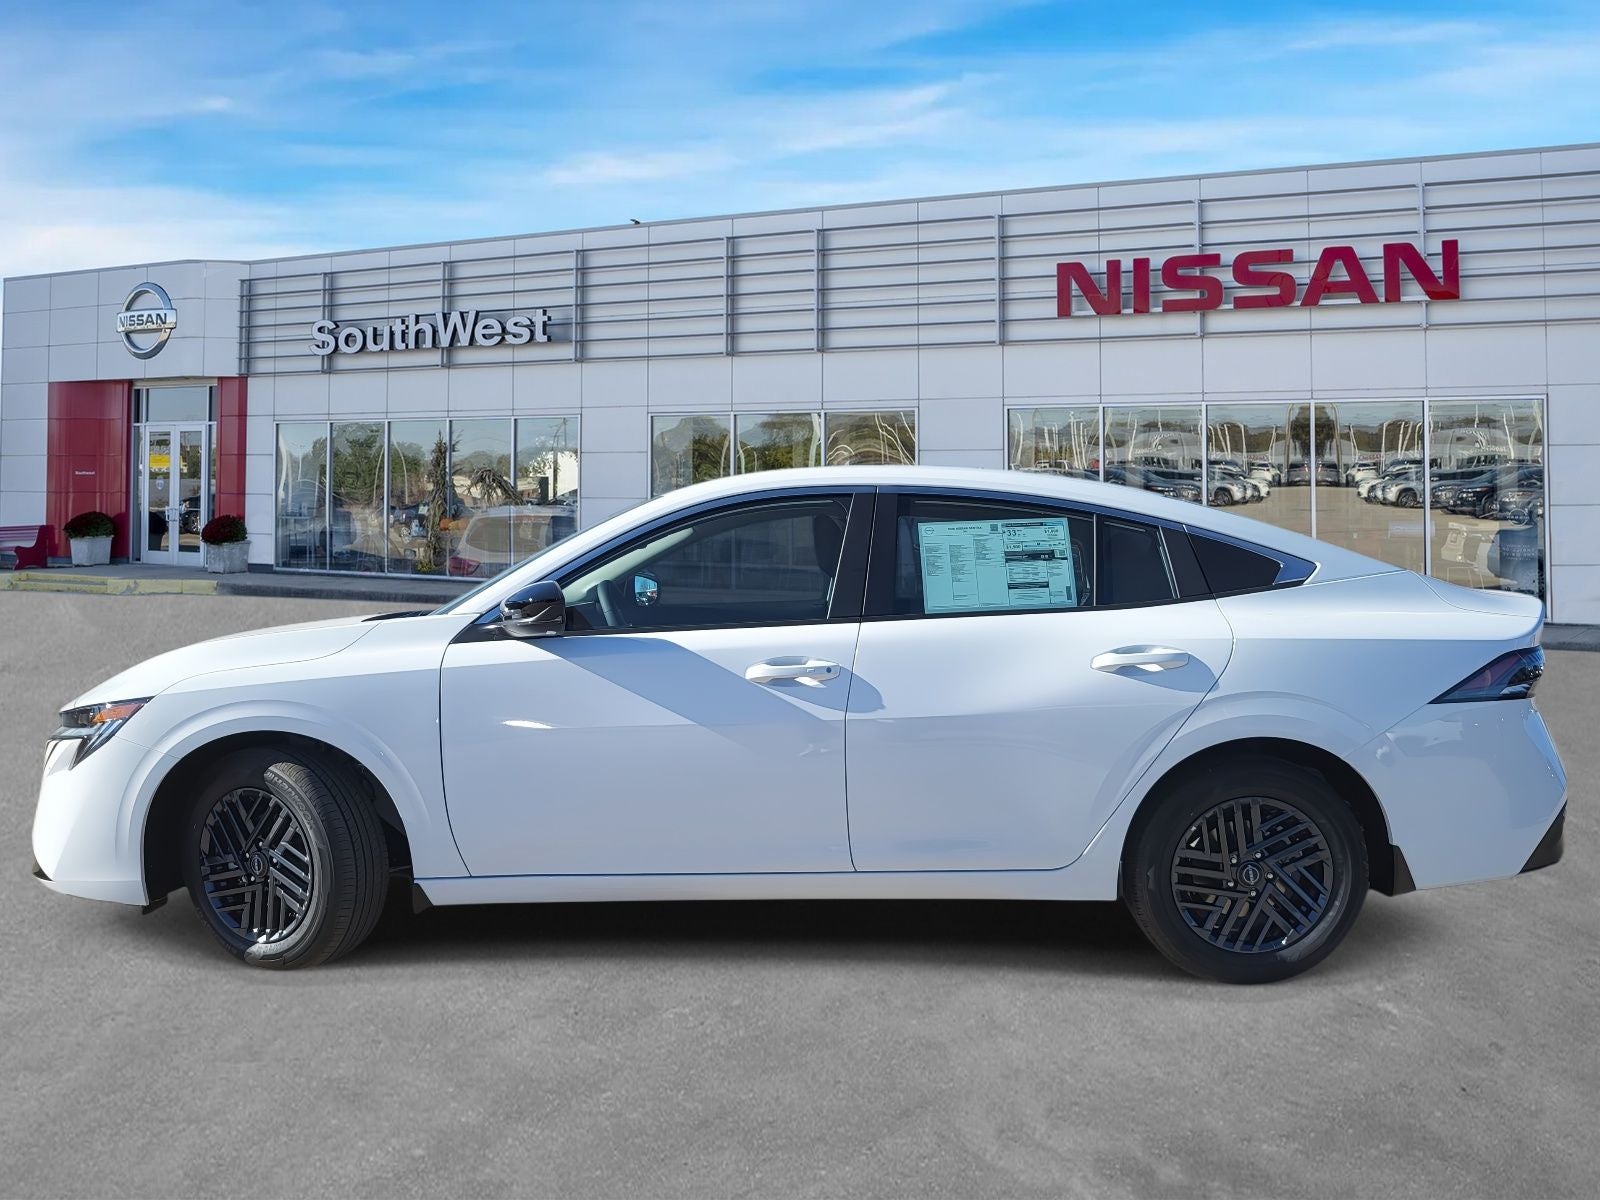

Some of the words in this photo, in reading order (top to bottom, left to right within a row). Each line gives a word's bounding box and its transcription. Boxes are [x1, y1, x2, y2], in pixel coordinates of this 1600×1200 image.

[1057, 239, 1460, 318] NISSAN
[119, 312, 167, 328] NISSAN
[309, 309, 551, 356] SouthWest
[1007, 529, 1016, 537] 33
